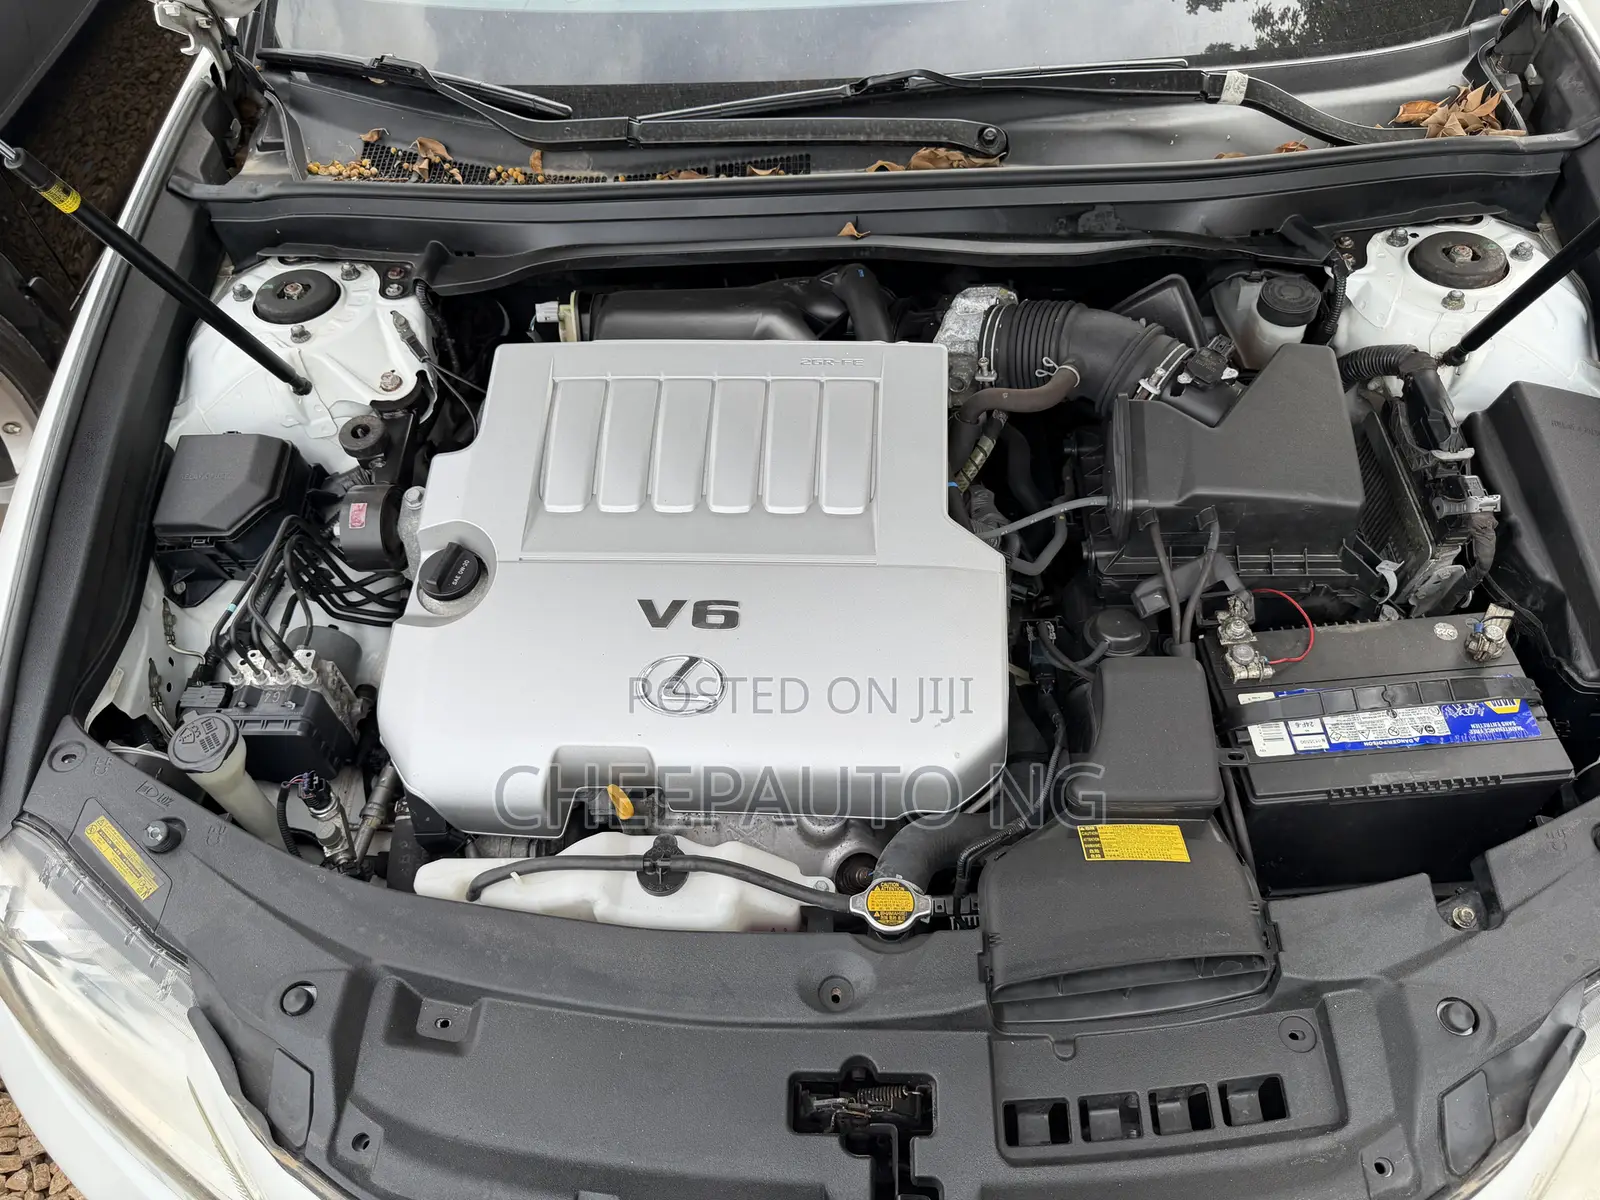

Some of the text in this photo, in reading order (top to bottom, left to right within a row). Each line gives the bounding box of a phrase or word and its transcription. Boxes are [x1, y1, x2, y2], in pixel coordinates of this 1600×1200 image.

[800, 356, 865, 368] 2GR-FE
[452, 559, 470, 586] SAE 0W-20
[636, 598, 741, 630] V6
[1484, 725, 1524, 733] MAINTENANCE
